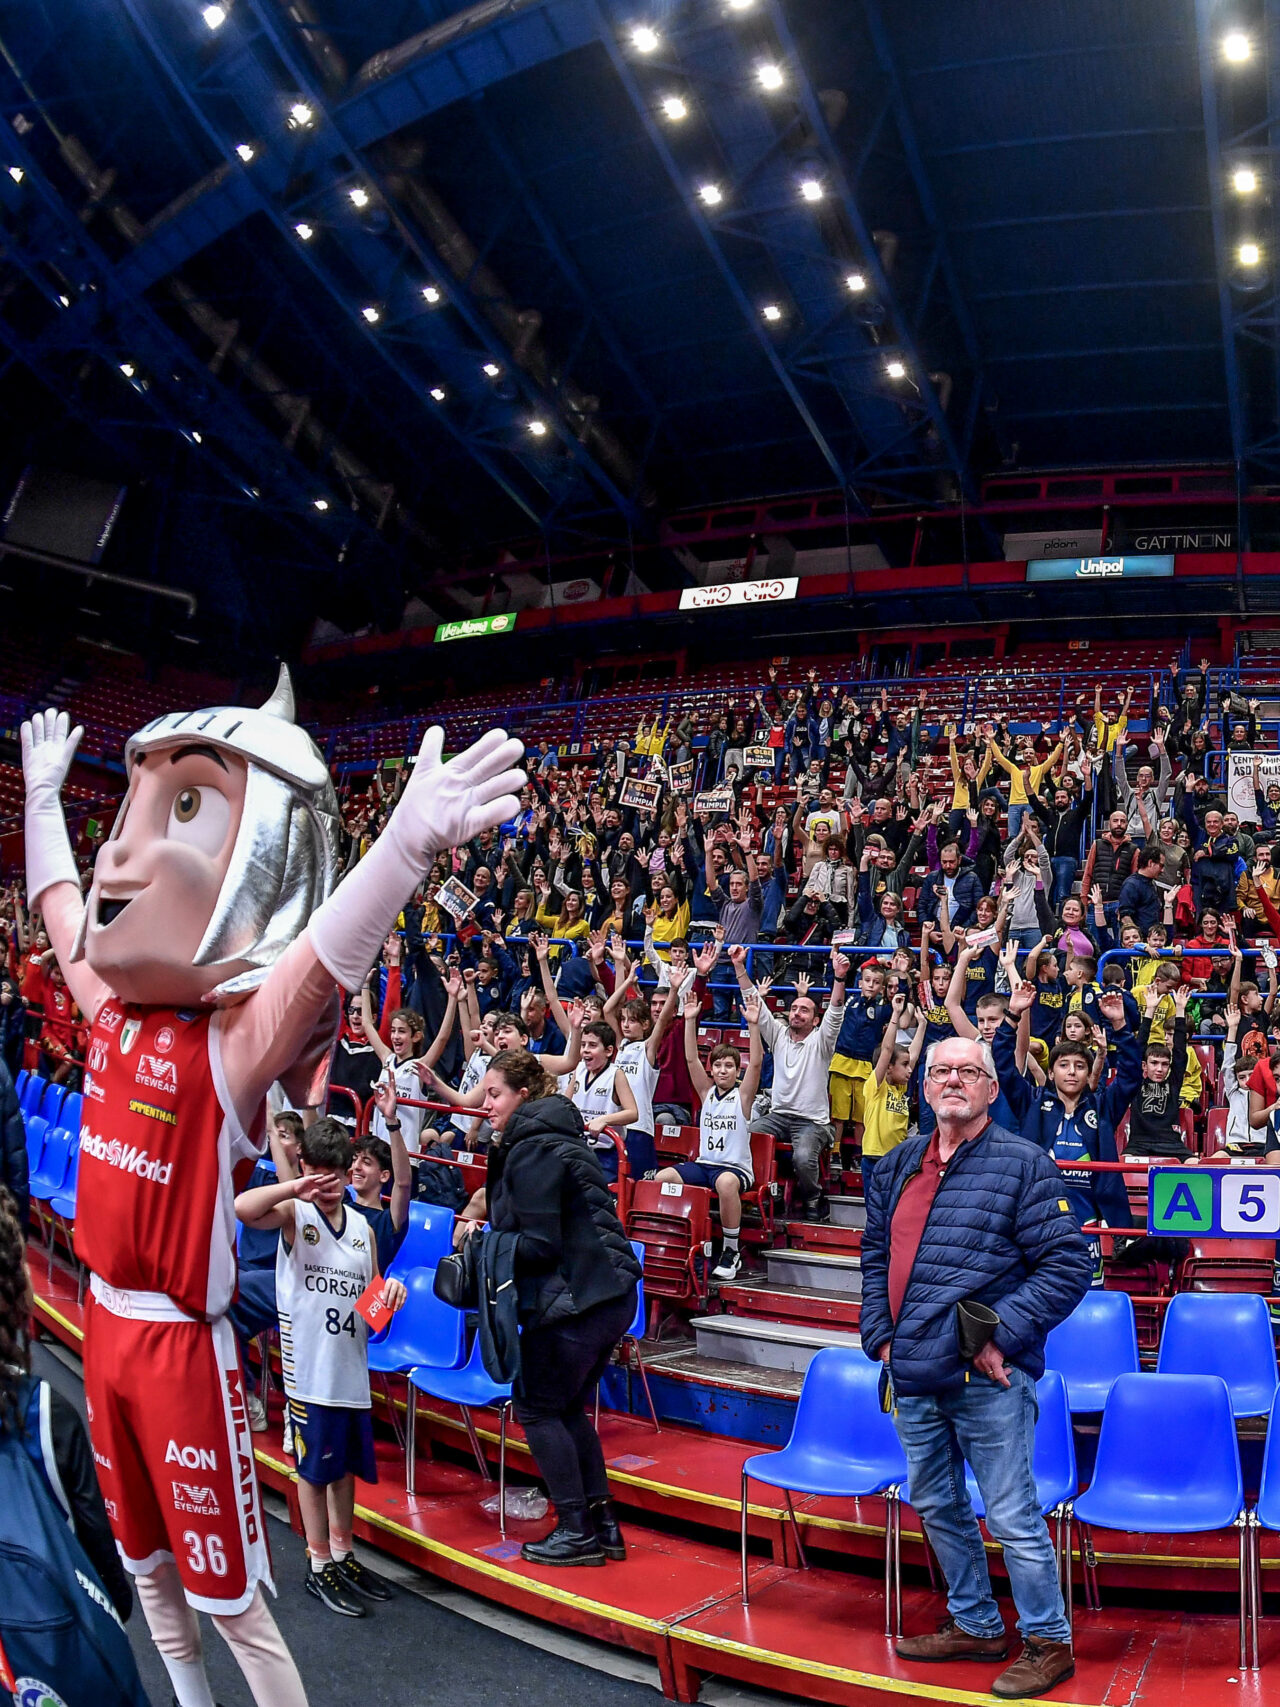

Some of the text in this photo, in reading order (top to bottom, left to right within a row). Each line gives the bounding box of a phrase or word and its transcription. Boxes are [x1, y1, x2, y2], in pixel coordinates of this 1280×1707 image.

[1043, 539, 1078, 554] ploom
[1080, 558, 1124, 577] Unipol
[966, 724, 972, 732] 4
[1233, 766, 1252, 776] ASD
[99, 1008, 122, 1029] EA7
[135, 1073, 176, 1095] EYEWEAR
[129, 1100, 177, 1125] SIMMENTHAL
[1141, 1095, 1167, 1115] 23
[667, 1127, 676, 1135] 14
[707, 1135, 725, 1152] 64
[667, 1184, 677, 1194] 15
[1163, 1183, 1266, 1222] A 5
[325, 1307, 356, 1338] 84
[164, 1440, 219, 1471] AON
[174, 1501, 220, 1516] EYEWEAR
[183, 1530, 228, 1577] 36
